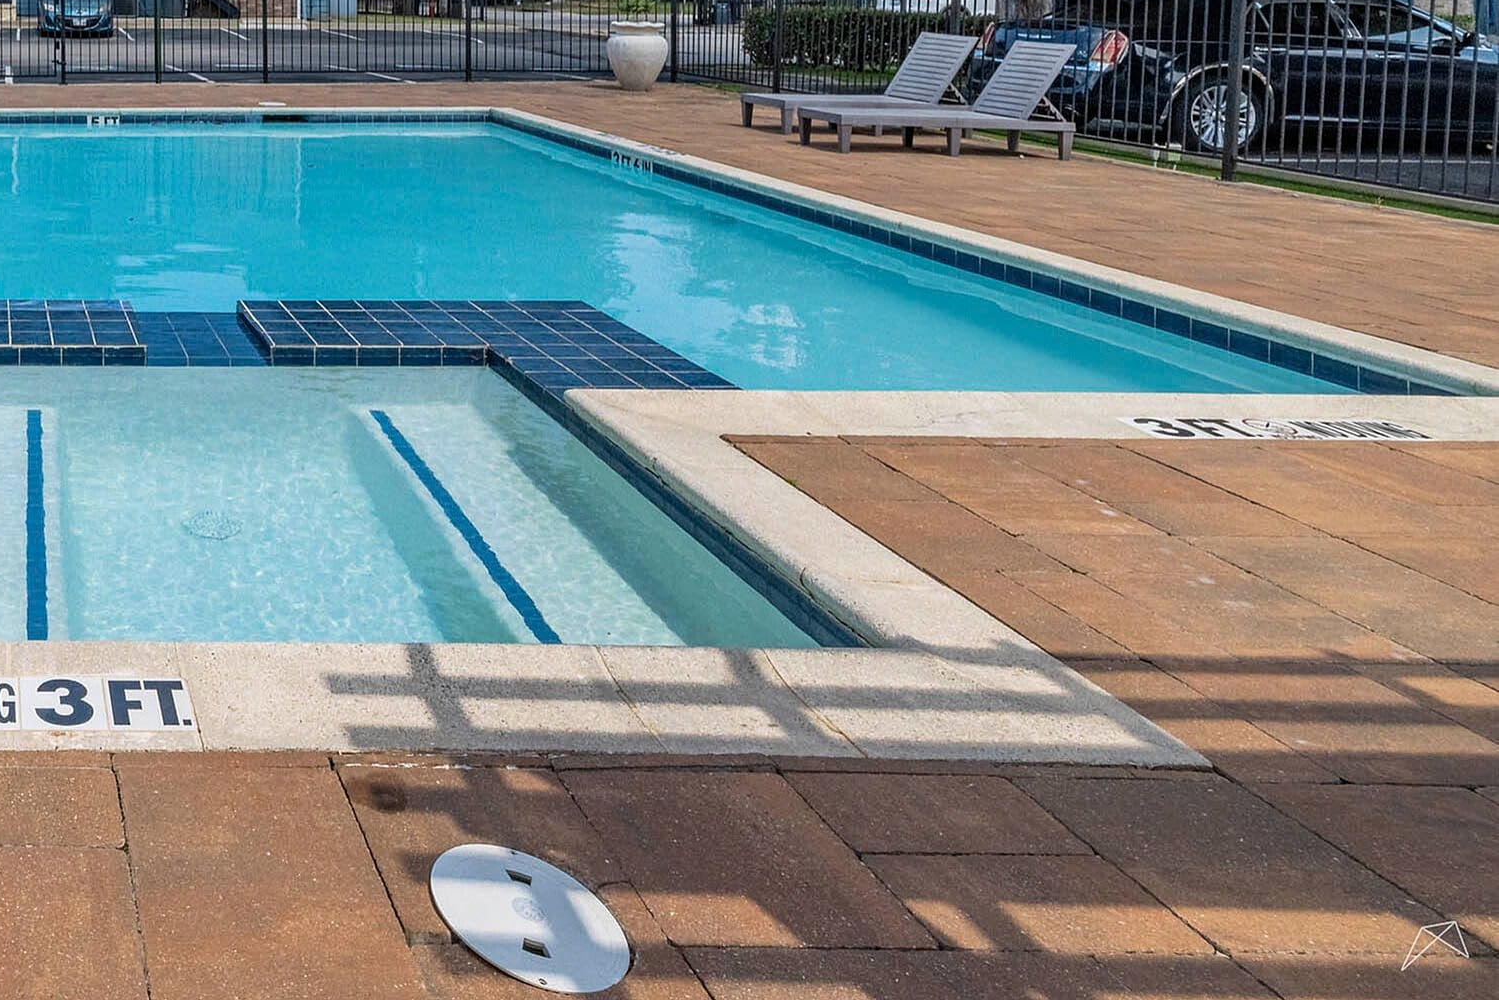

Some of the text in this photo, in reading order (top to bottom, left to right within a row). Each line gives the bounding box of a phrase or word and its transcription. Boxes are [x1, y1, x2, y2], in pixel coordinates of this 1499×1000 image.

[1133, 418, 1196, 437] 3
[1320, 421, 1434, 439] DIVING
[34, 678, 94, 727] 3
[107, 679, 193, 726] FT.
